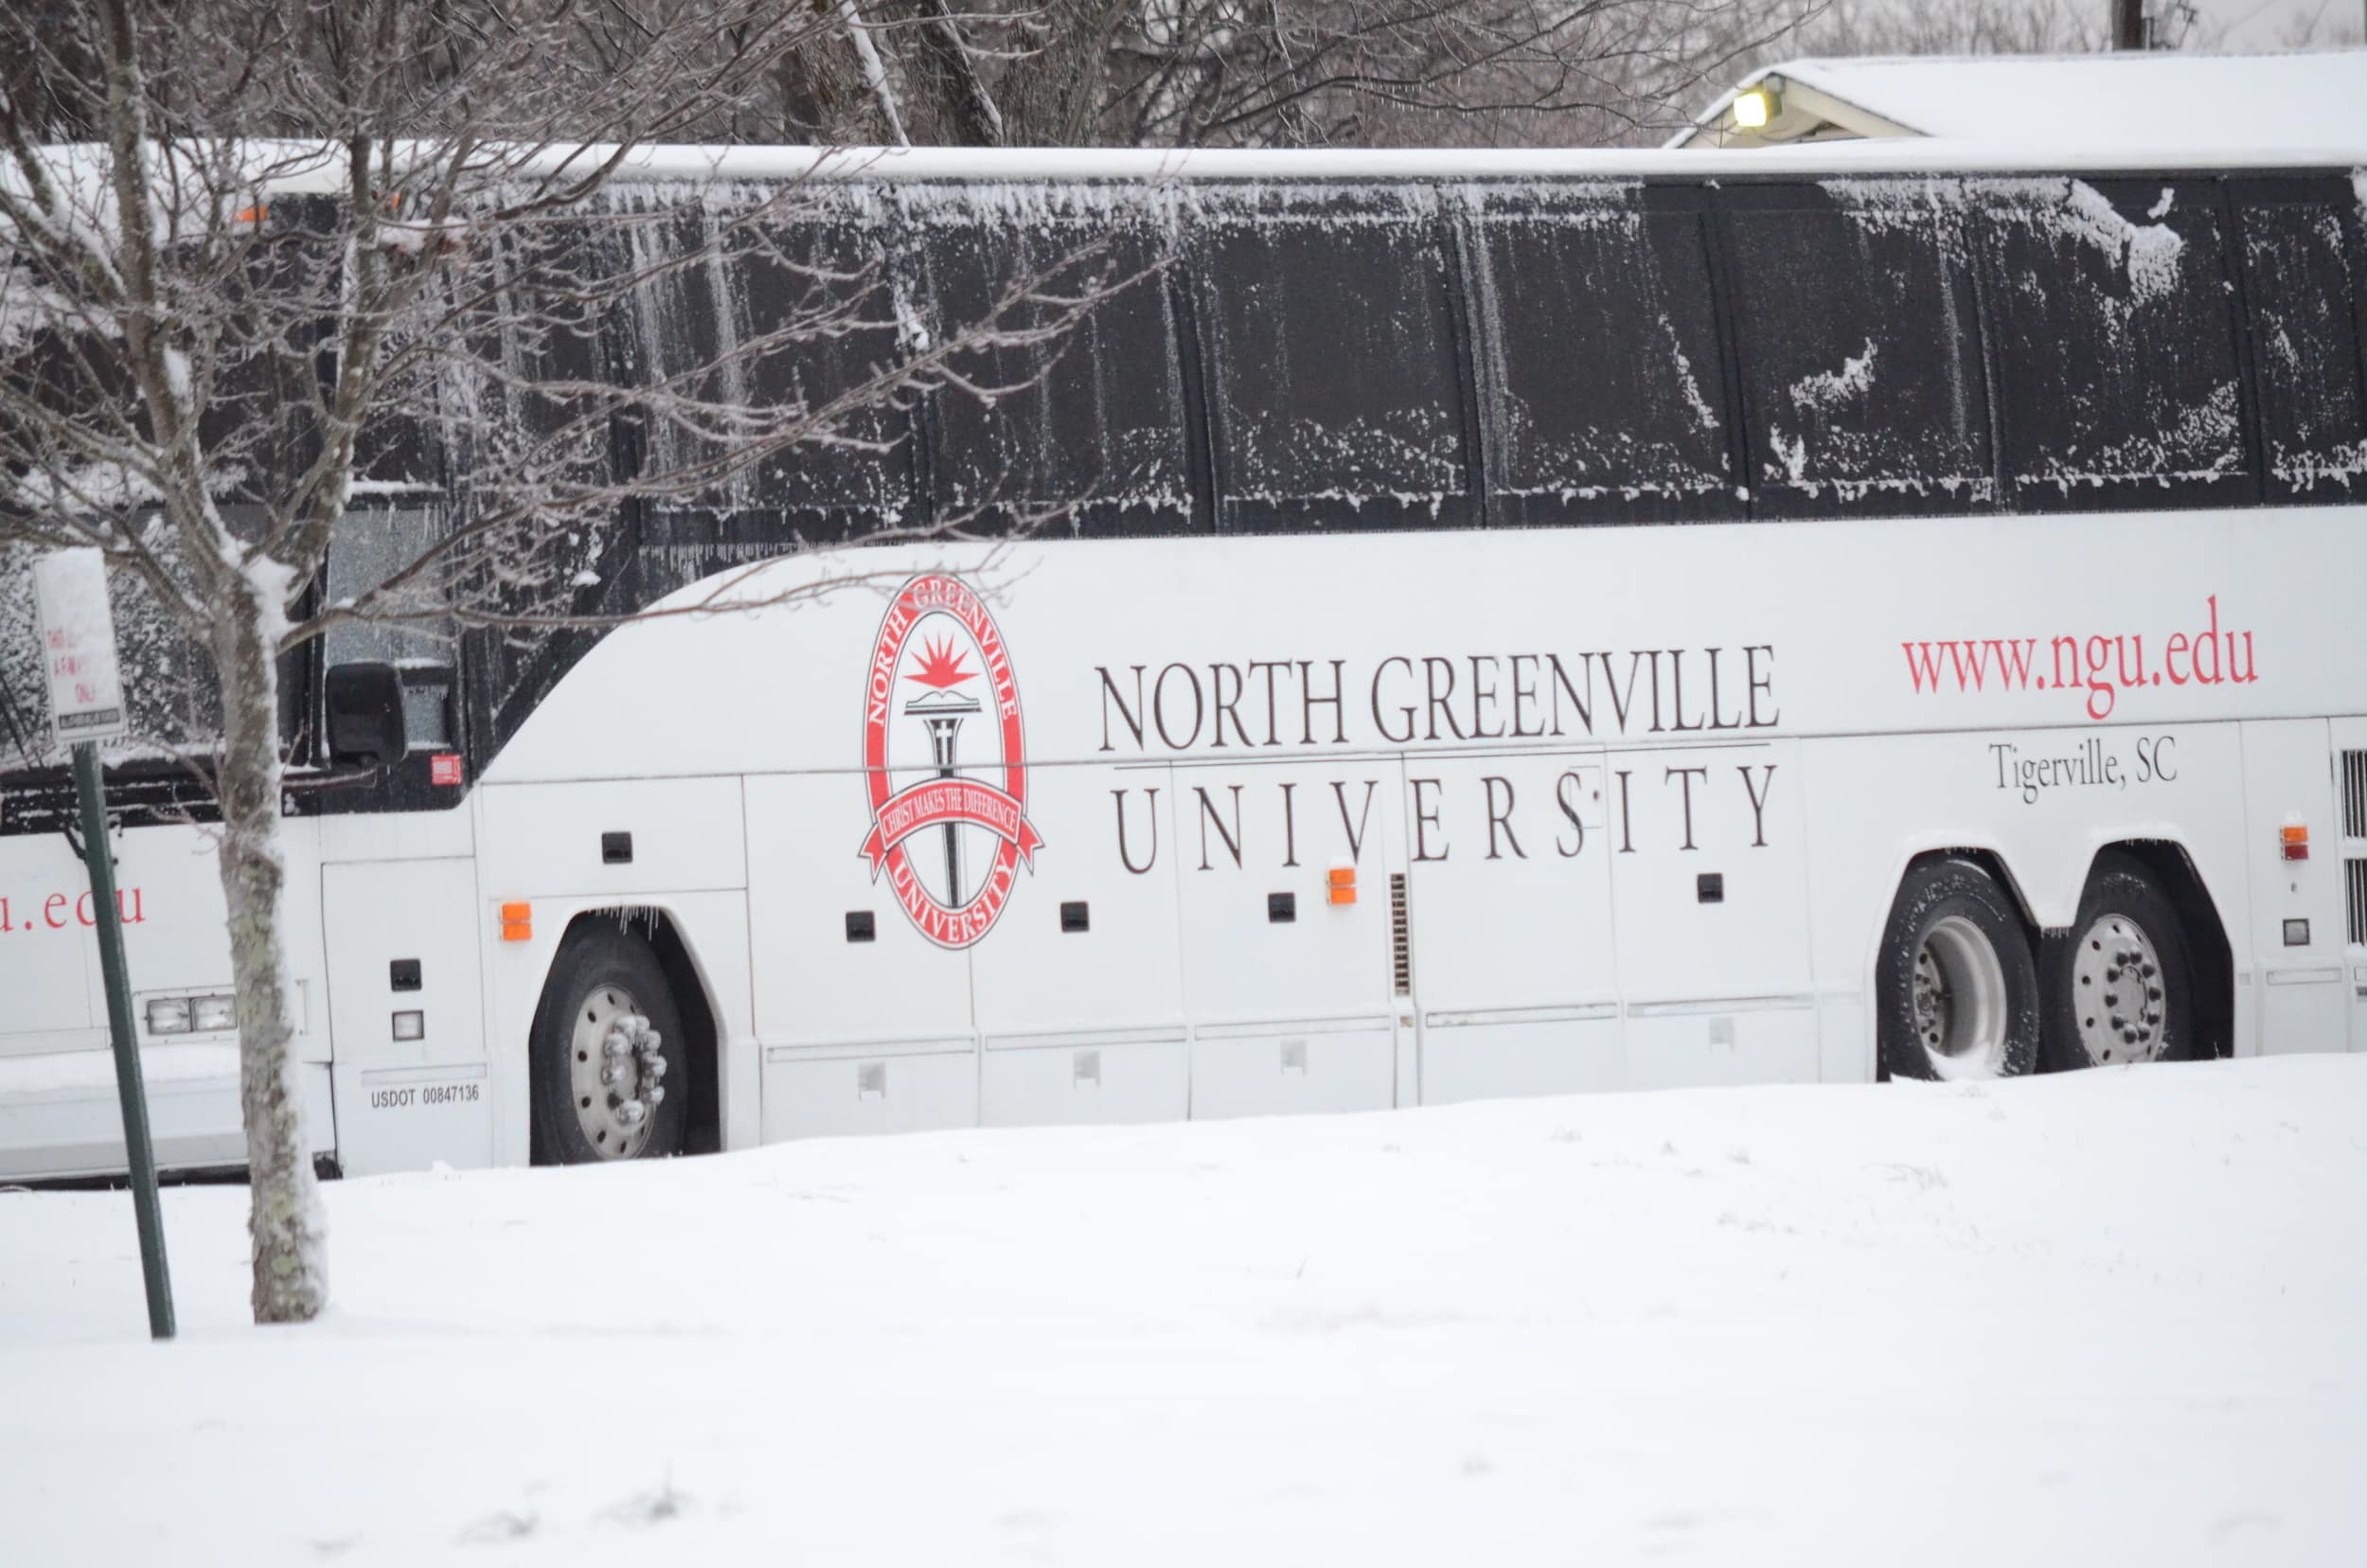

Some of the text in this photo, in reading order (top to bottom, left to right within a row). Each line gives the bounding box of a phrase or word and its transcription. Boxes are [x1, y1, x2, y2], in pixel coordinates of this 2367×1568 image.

[868, 579, 1018, 727] NORTH GREENVILLE
[1095, 645, 1782, 753] NORTH GREENVILLE
[1901, 594, 2259, 722] www.ngu.edu
[881, 787, 1017, 838] CHRIST MAKES THE DIFFERENCE
[1111, 763, 1779, 875] UNIVERSITY
[1989, 735, 2178, 805] Tigerville, SC
[893, 853, 1015, 943] UNIVERSITY
[371, 1083, 480, 1109] USDOT 00847136
